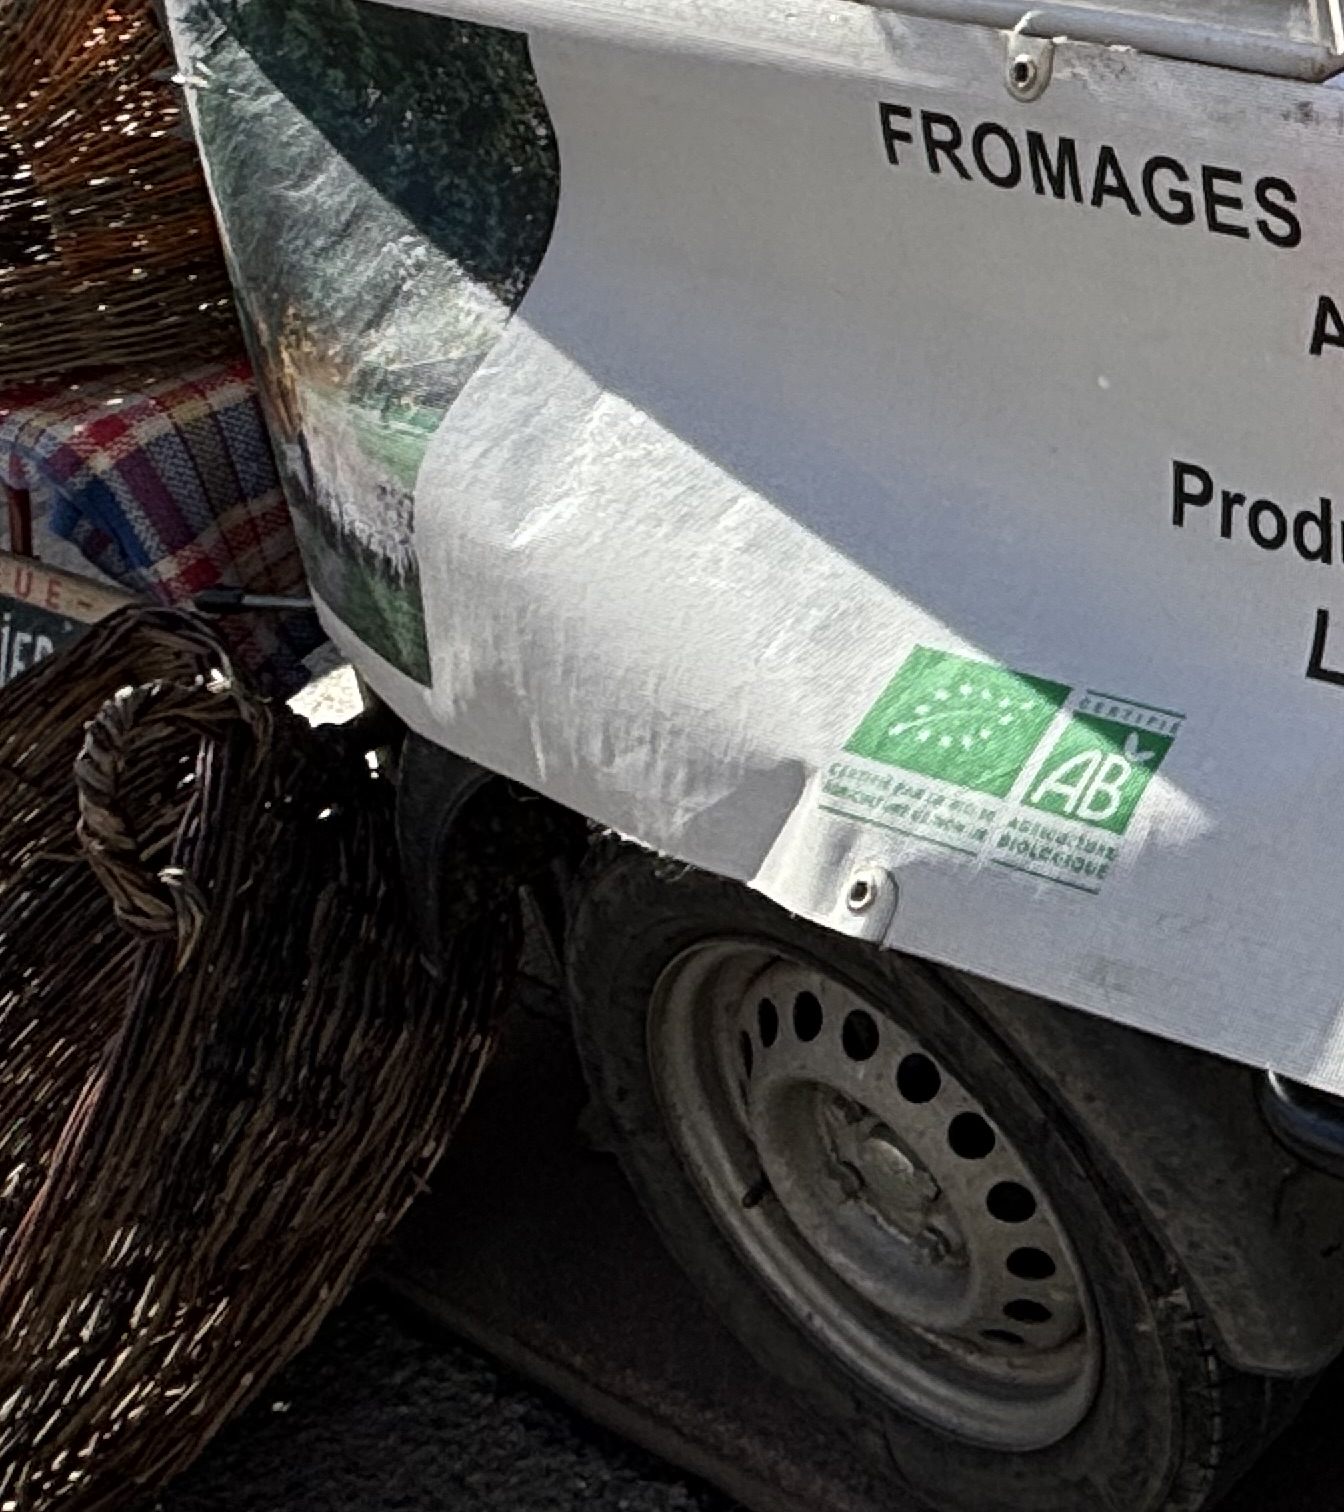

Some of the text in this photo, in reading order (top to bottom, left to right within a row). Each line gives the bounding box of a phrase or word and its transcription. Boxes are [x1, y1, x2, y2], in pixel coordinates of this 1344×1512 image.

[878, 101, 1302, 249] FROMAGES
[1030, 749, 1132, 821] AB
[996, 831, 1109, 879] BIOLOGIQUE
